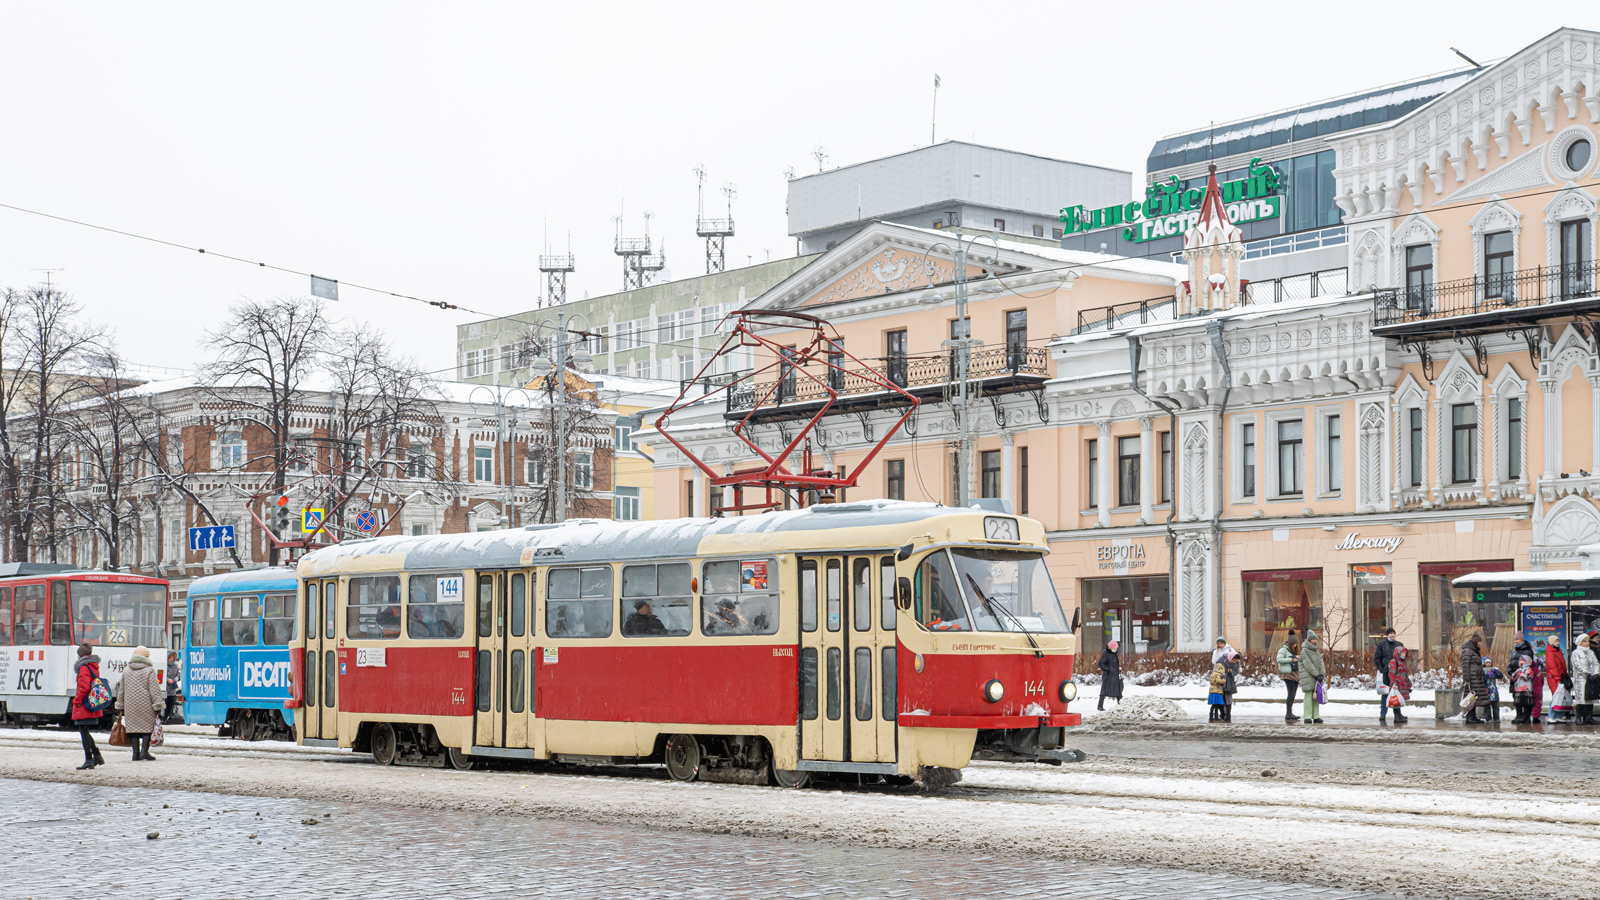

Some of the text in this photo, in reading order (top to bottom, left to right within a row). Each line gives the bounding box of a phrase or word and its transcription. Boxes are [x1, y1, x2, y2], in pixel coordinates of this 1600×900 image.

[1142, 200, 1274, 240] ГАСТРОМЪ
[989, 519, 1013, 540] 23
[1335, 532, 1404, 553] Mercury
[1097, 544, 1146, 560] ЕВРОПА
[1128, 560, 1146, 569] ЦЕНТР
[440, 579, 458, 595] 144
[1526, 612, 1563, 620] СЧАСТЛИВЫЙ
[109, 630, 126, 645] 26
[190, 649, 205, 665] ТВОЙ
[358, 649, 367, 665] 23
[772, 648, 794, 657] ВЫХОД
[17, 668, 43, 690] KFC
[190, 665, 231, 681] СПОРТИВНЫЙ
[190, 684, 216, 697] МАГАЗИН
[1024, 680, 1045, 697] 144
[451, 691, 465, 705] 144
